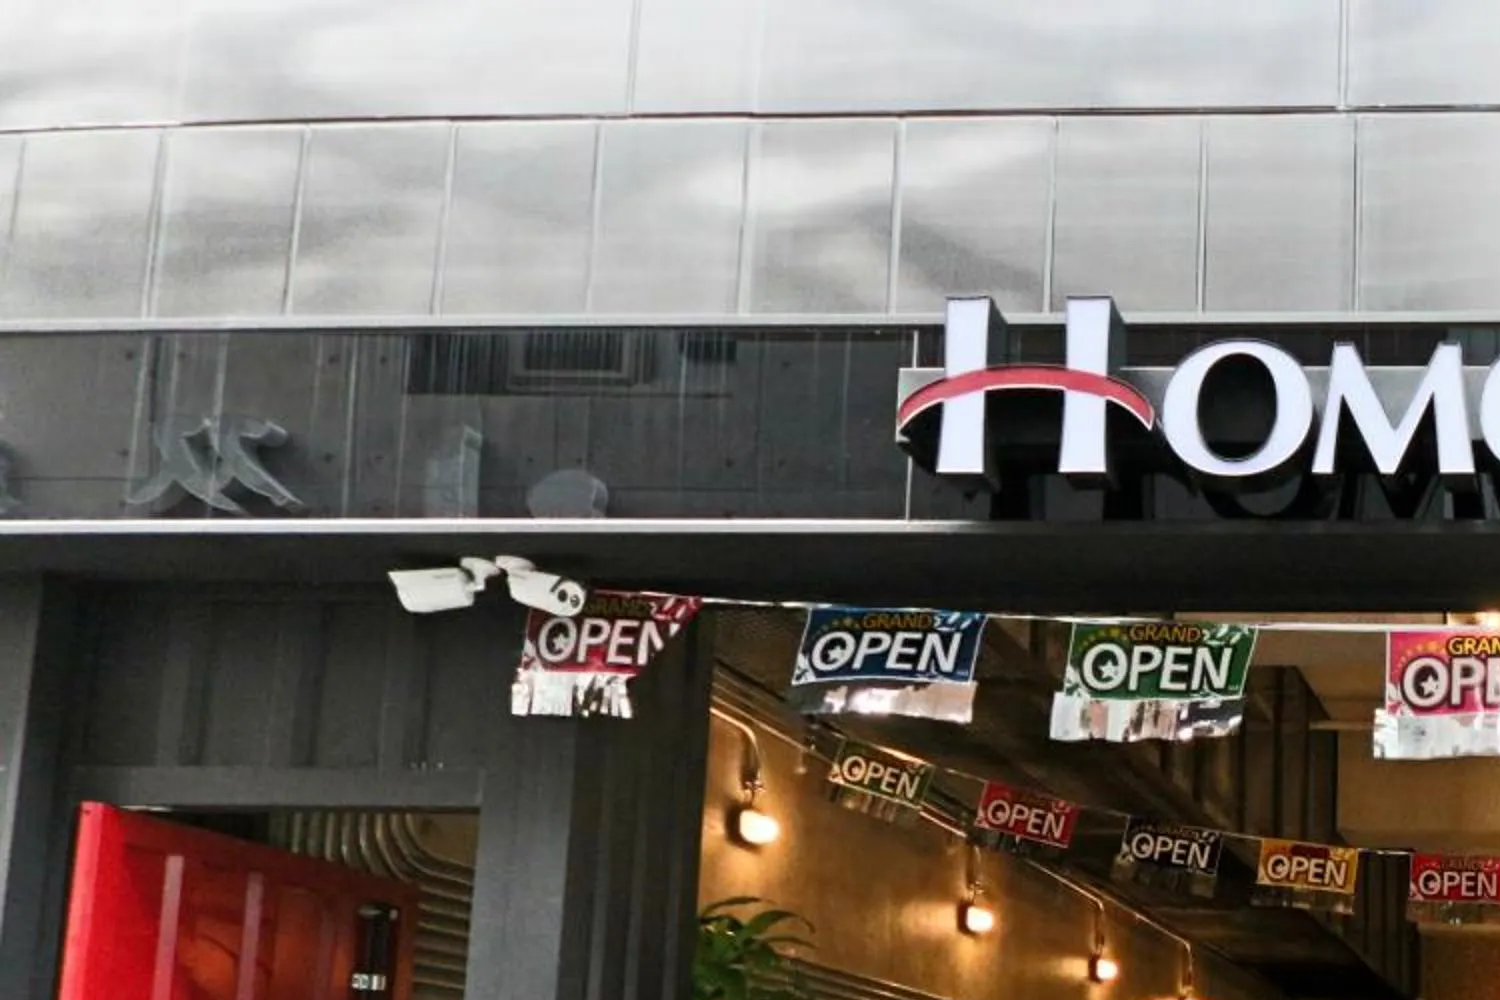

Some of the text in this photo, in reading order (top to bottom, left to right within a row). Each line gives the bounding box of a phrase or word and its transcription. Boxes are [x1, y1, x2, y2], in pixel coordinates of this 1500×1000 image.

[863, 613, 932, 629] GRAND
[1129, 623, 1201, 643] GRAND
[811, 630, 963, 673] OPEN
[1082, 643, 1233, 692] OPEN
[842, 755, 921, 799] OPEN
[987, 799, 1066, 839] OPEN
[1131, 832, 1212, 869] OPEN
[1267, 854, 1348, 887] OPEN
[1418, 869, 1498, 898] OPEN
